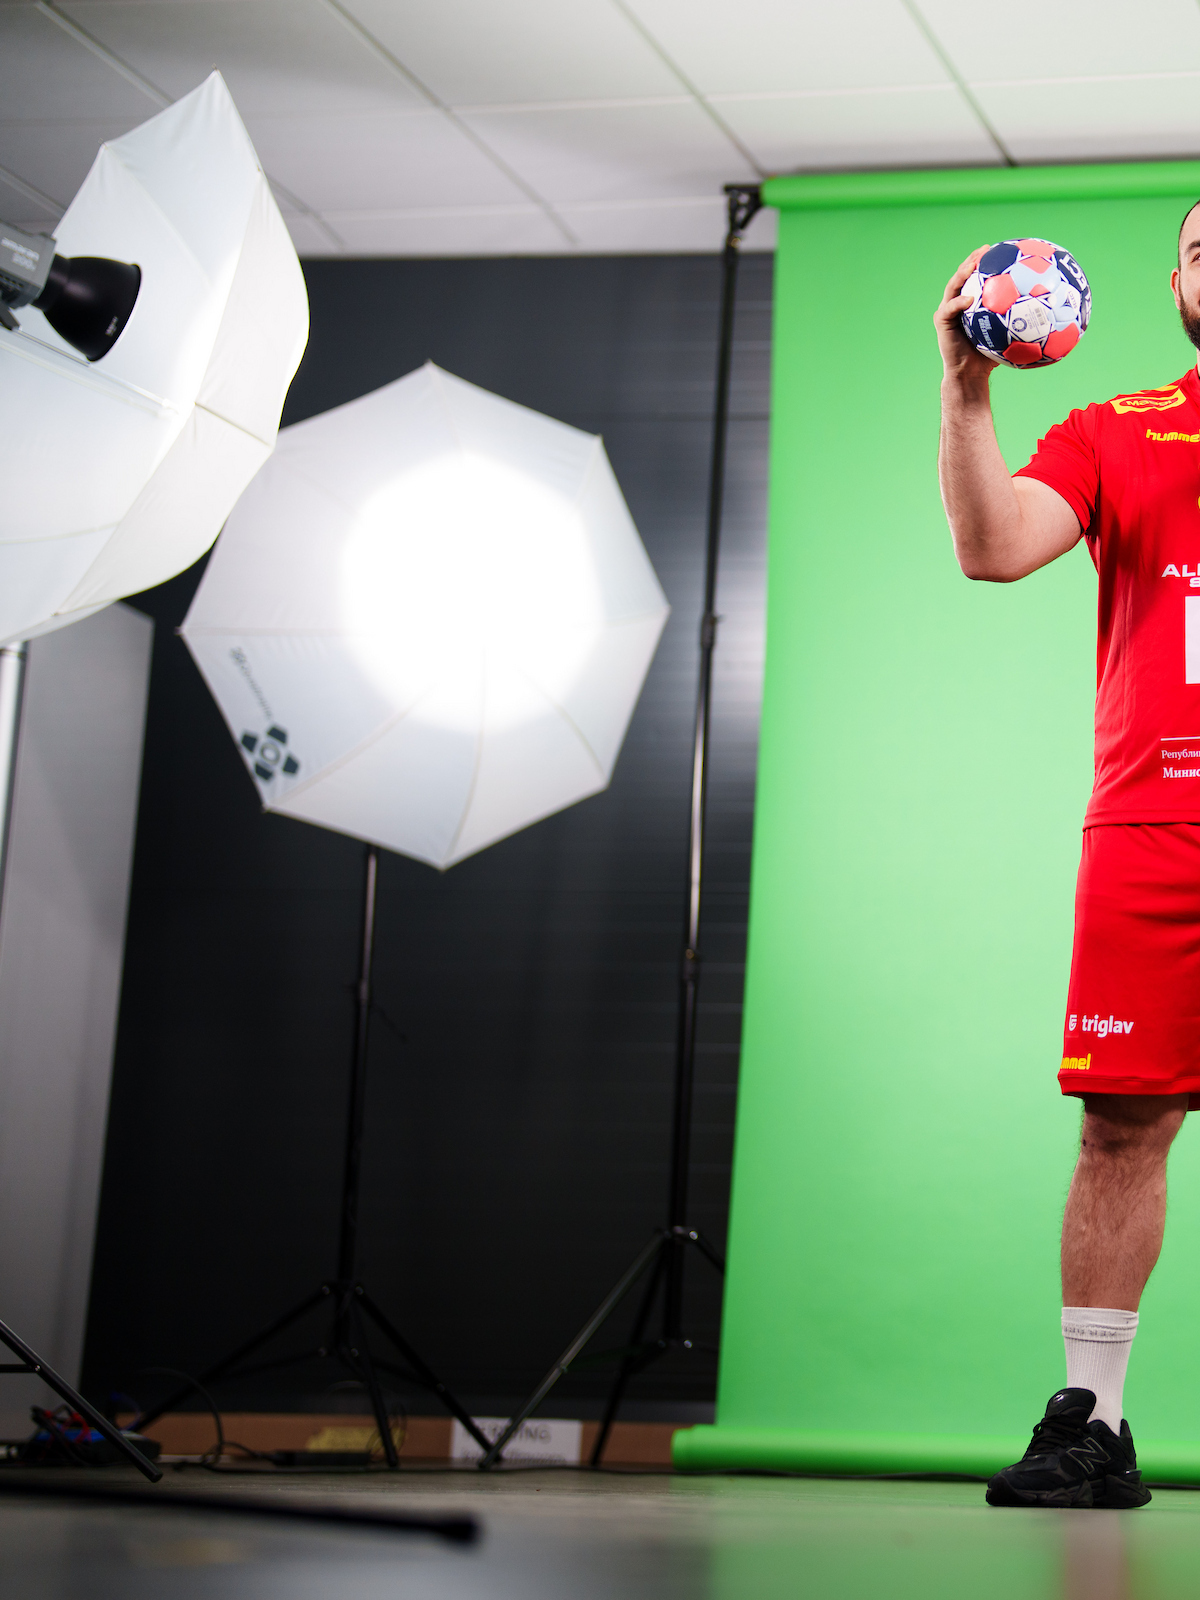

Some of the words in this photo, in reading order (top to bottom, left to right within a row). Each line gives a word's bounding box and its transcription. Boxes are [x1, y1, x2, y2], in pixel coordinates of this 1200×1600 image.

[978, 318, 995, 349] GREATNESS
[983, 315, 993, 330] PURE
[1081, 1014, 1135, 1039] triglav
